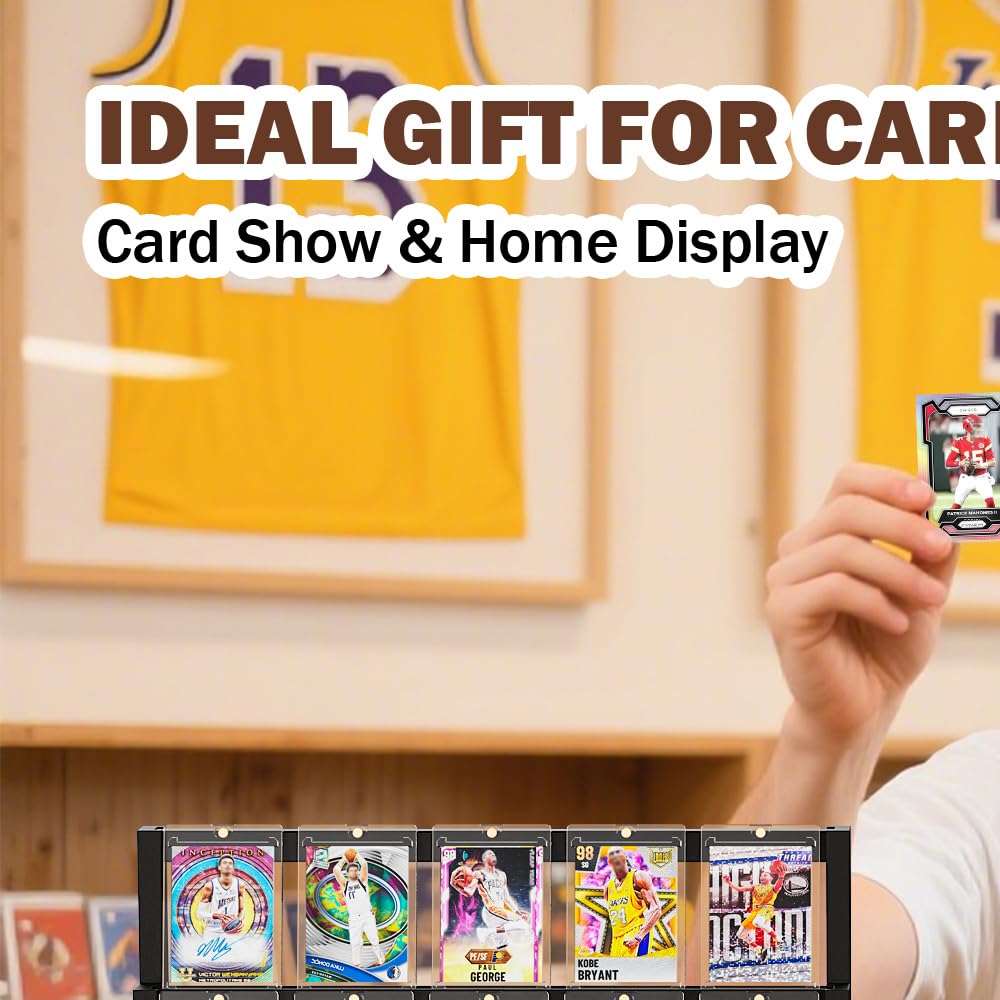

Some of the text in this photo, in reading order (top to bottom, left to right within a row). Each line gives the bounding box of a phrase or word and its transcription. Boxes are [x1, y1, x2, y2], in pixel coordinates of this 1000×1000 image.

[180, 849, 265, 857] INCEPTION
[576, 846, 594, 861] 98
[577, 959, 599, 968] KOBE
[470, 972, 506, 982] GEORGE
[577, 970, 618, 980] BRYANT
